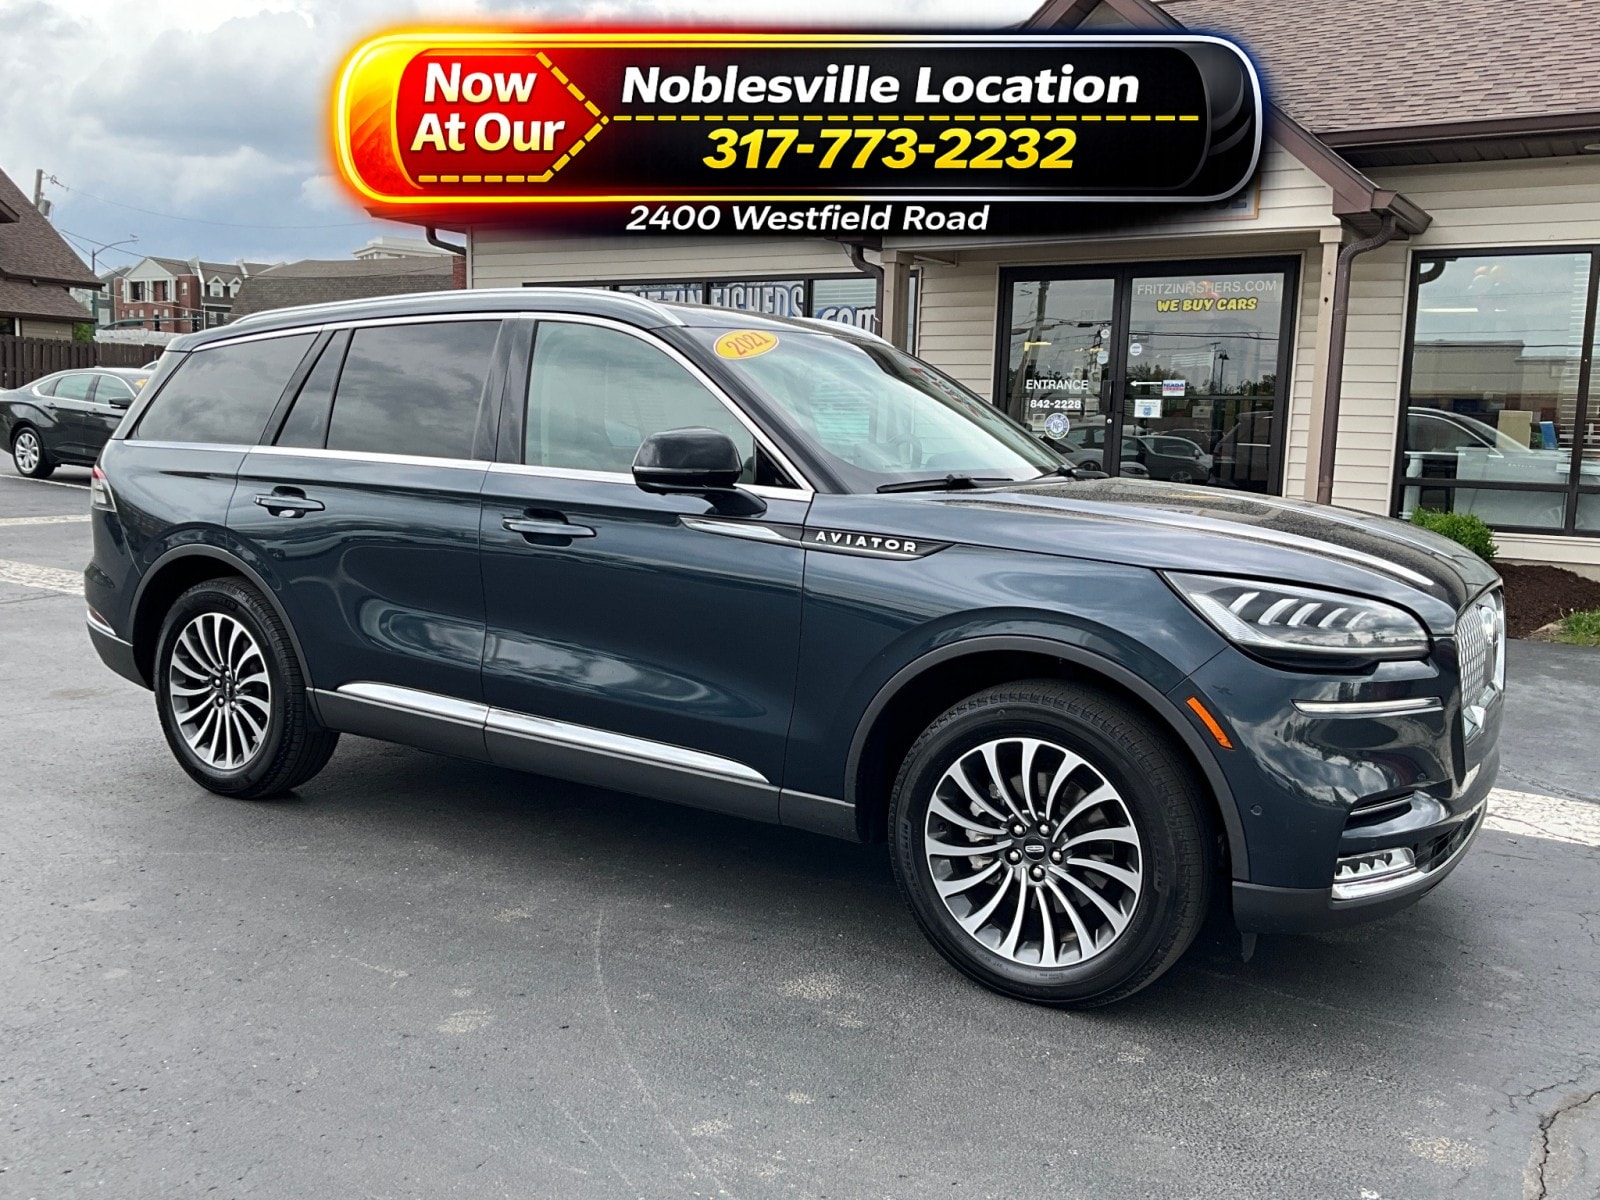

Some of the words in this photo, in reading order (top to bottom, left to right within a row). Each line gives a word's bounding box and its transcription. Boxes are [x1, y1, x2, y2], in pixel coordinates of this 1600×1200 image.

[1137, 280, 1277, 296] FRITZINFISHERS.COM
[1157, 299, 1180, 312] WE
[1182, 299, 1214, 312] BUY
[1216, 297, 1258, 311] CARS
[726, 332, 769, 355] 2021
[1026, 379, 1089, 390] ENTRANCE
[1030, 399, 1081, 409] 842-2228
[815, 530, 917, 552] AVIATOR
